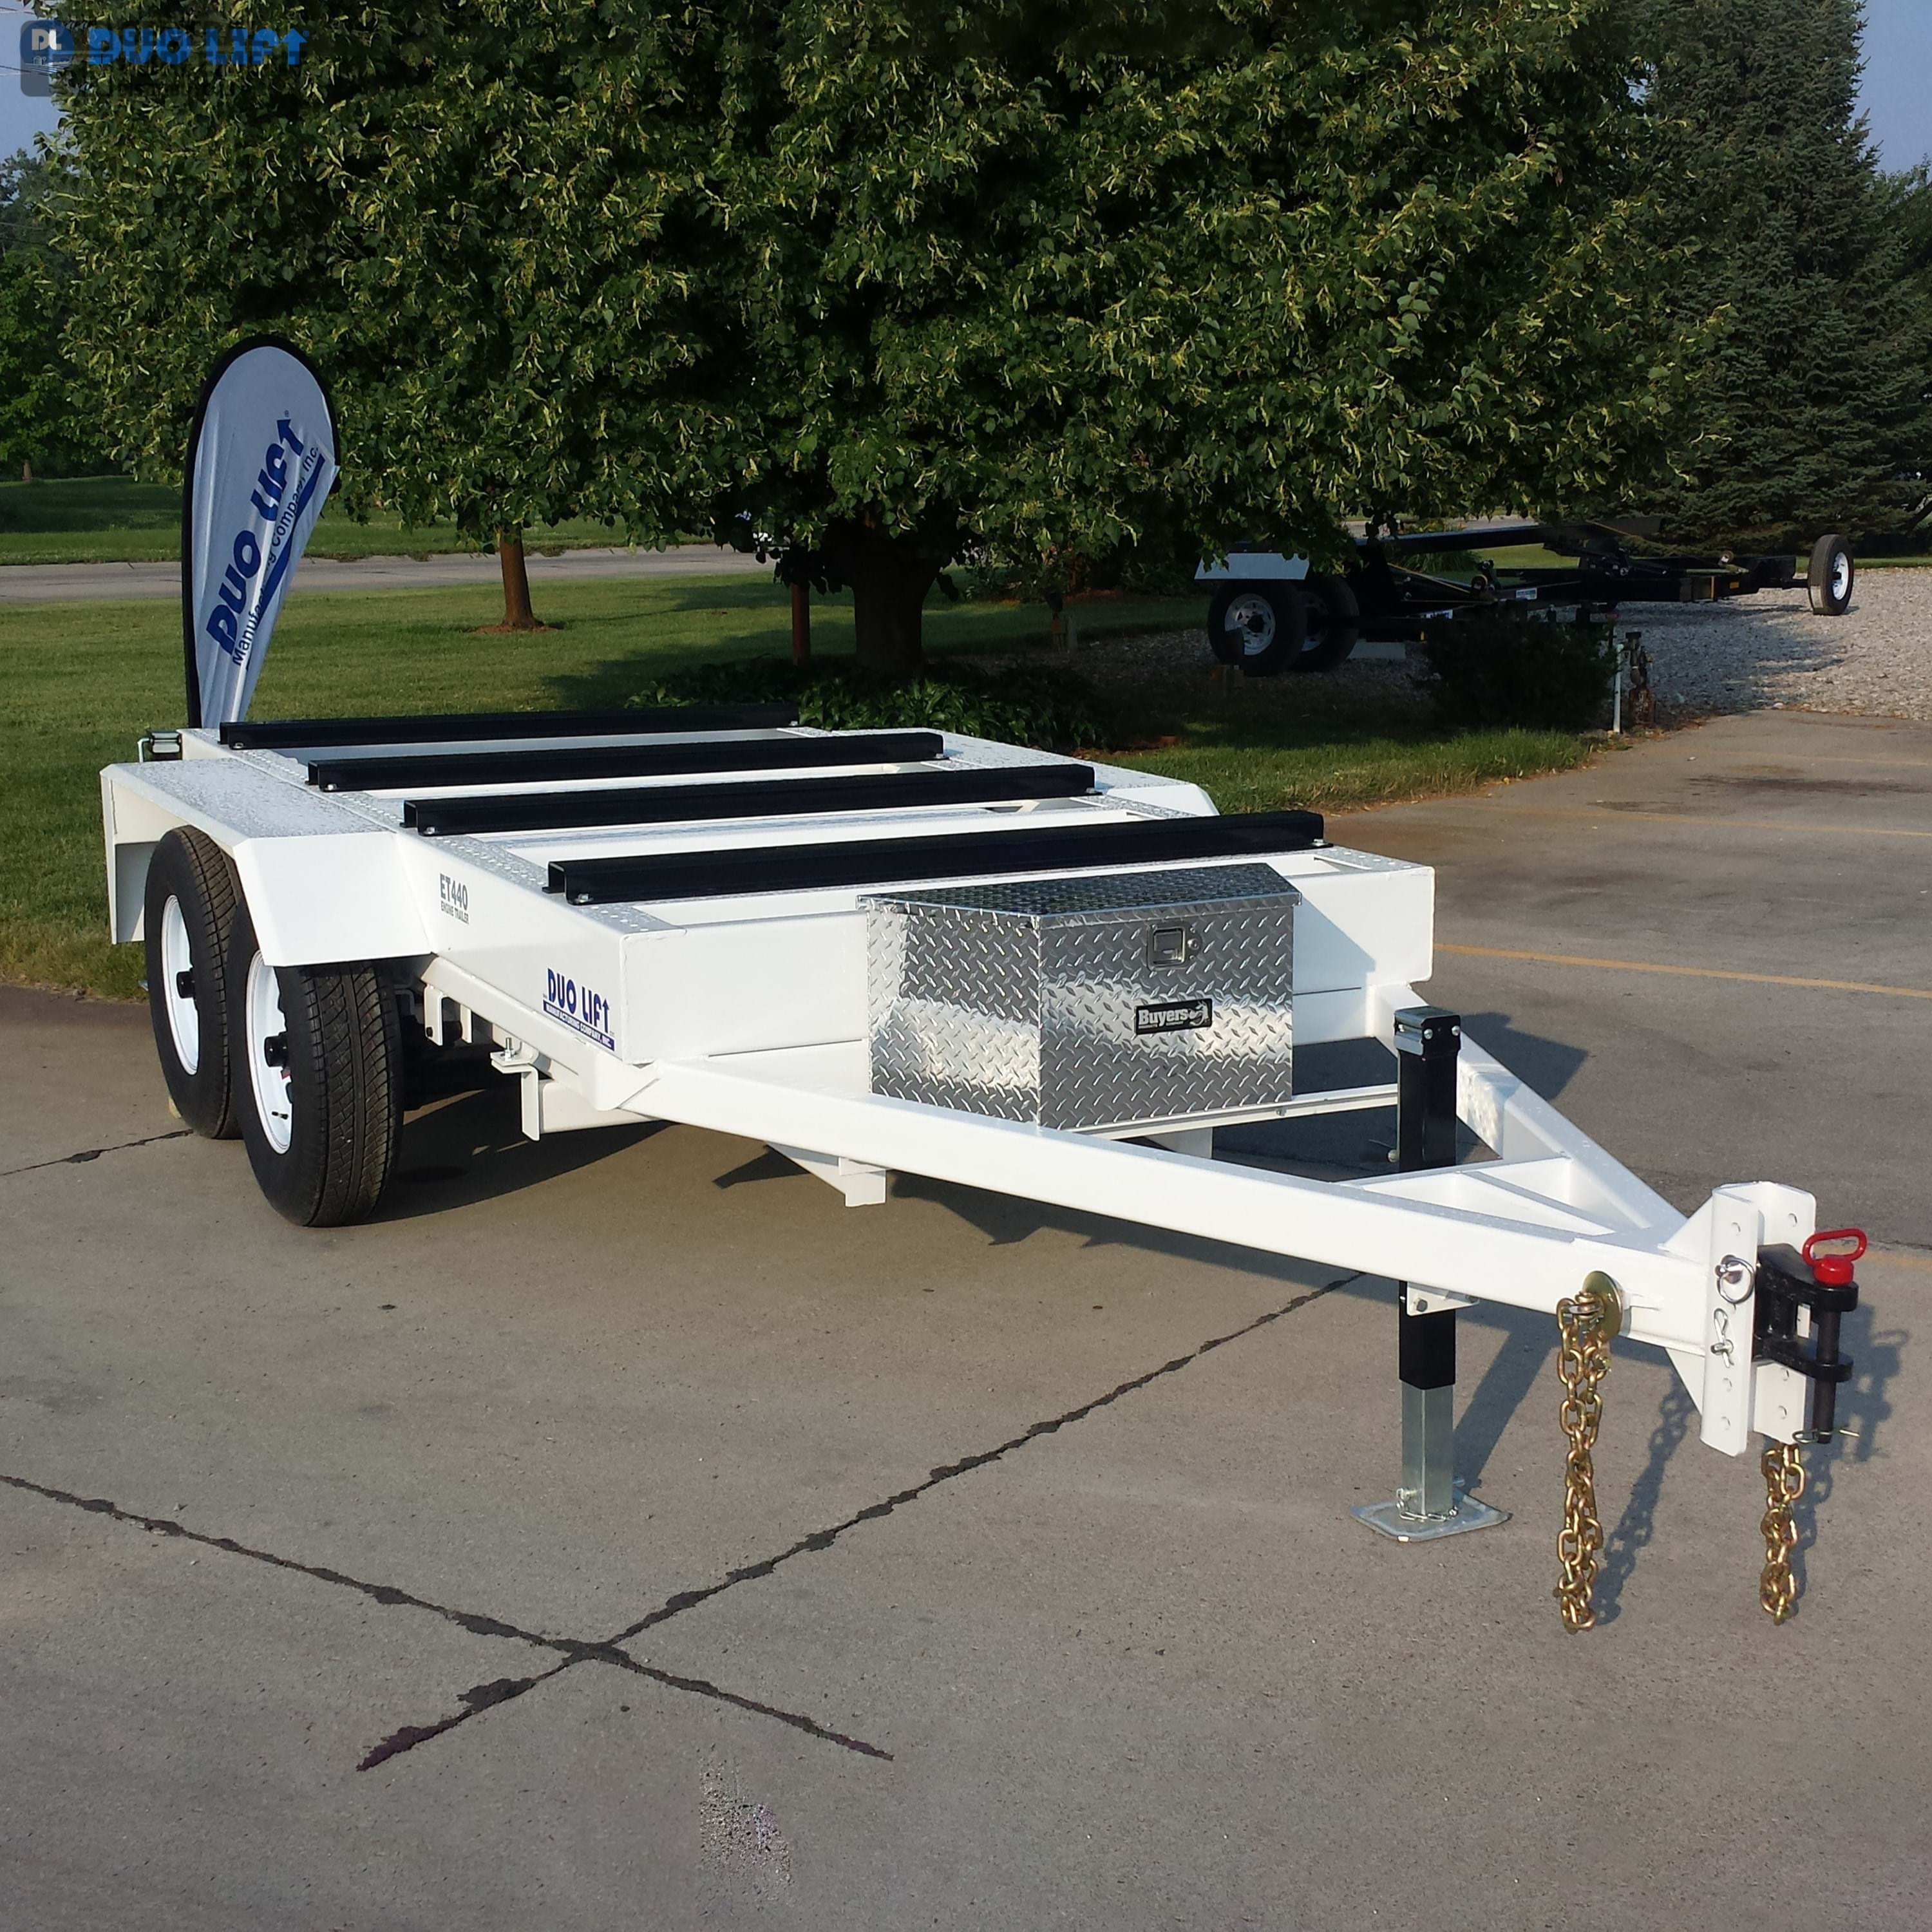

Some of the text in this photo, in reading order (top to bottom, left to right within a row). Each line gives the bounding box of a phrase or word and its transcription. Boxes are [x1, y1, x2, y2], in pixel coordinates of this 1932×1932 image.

[302, 447, 318, 472] Inc.
[206, 419, 304, 656] DUO LIFT
[440, 873, 468, 911] ET440
[547, 967, 610, 1034] DUO LIFT
[1138, 1009, 1188, 1027] Buyers
